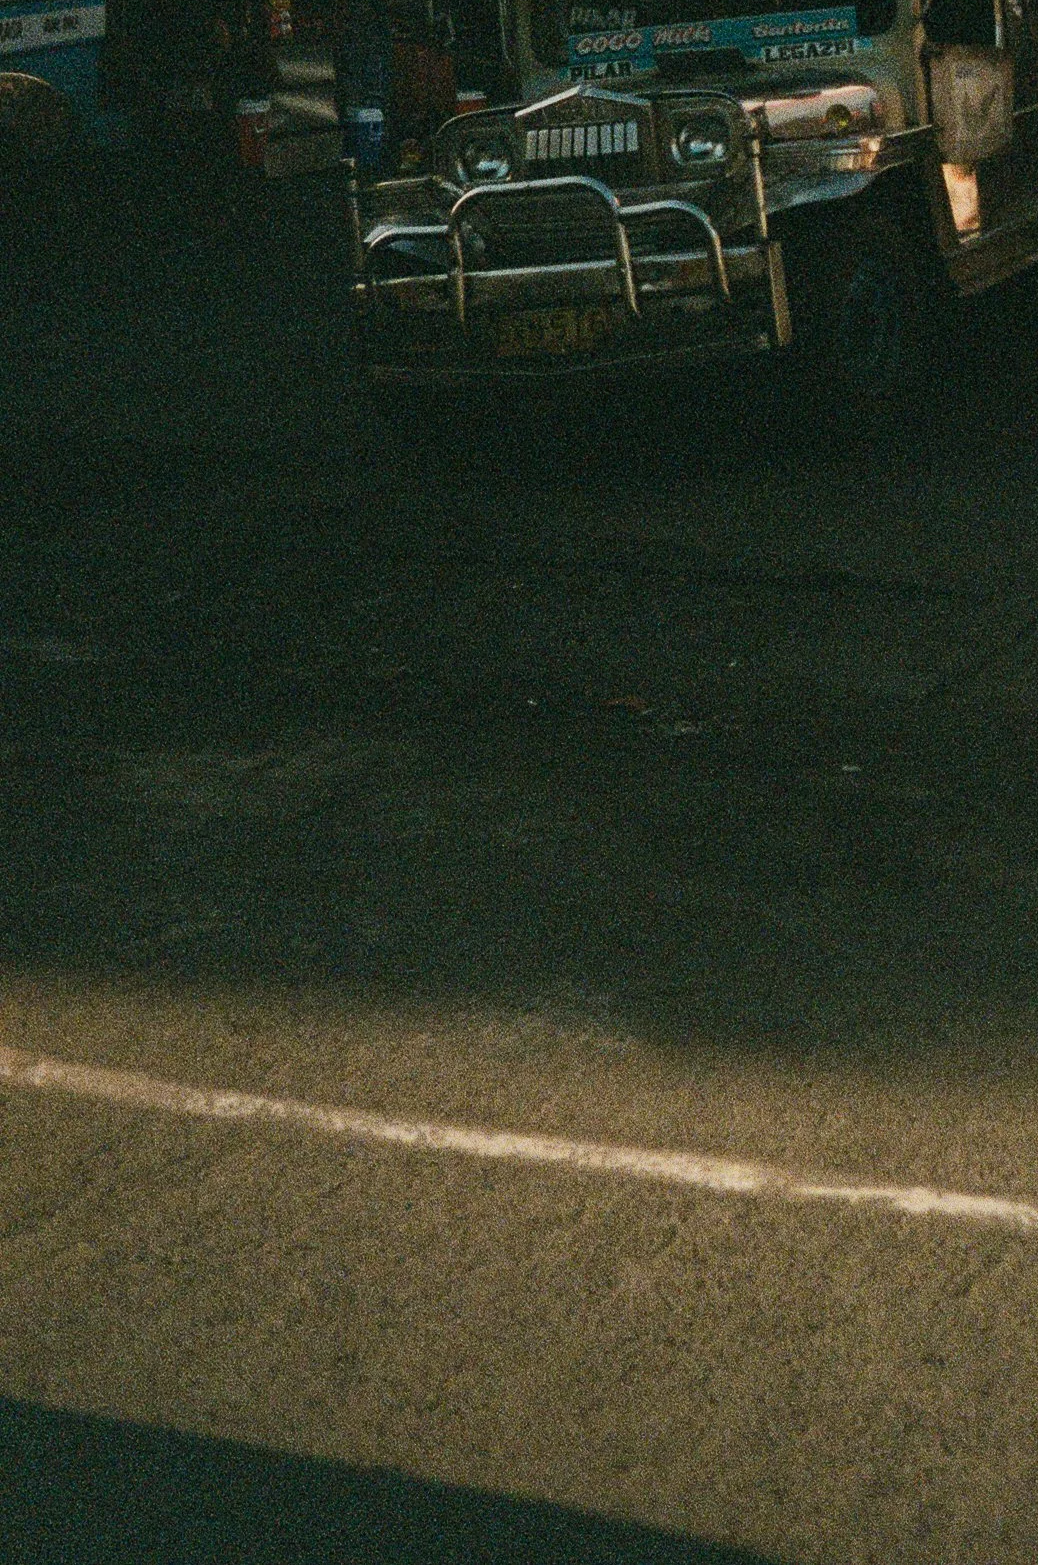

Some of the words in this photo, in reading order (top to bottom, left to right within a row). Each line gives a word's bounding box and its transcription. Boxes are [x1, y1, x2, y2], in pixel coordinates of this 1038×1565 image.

[575, 30, 643, 55] COCO
[765, 38, 855, 63] LEGAZPI
[570, 61, 632, 82] PILAR
